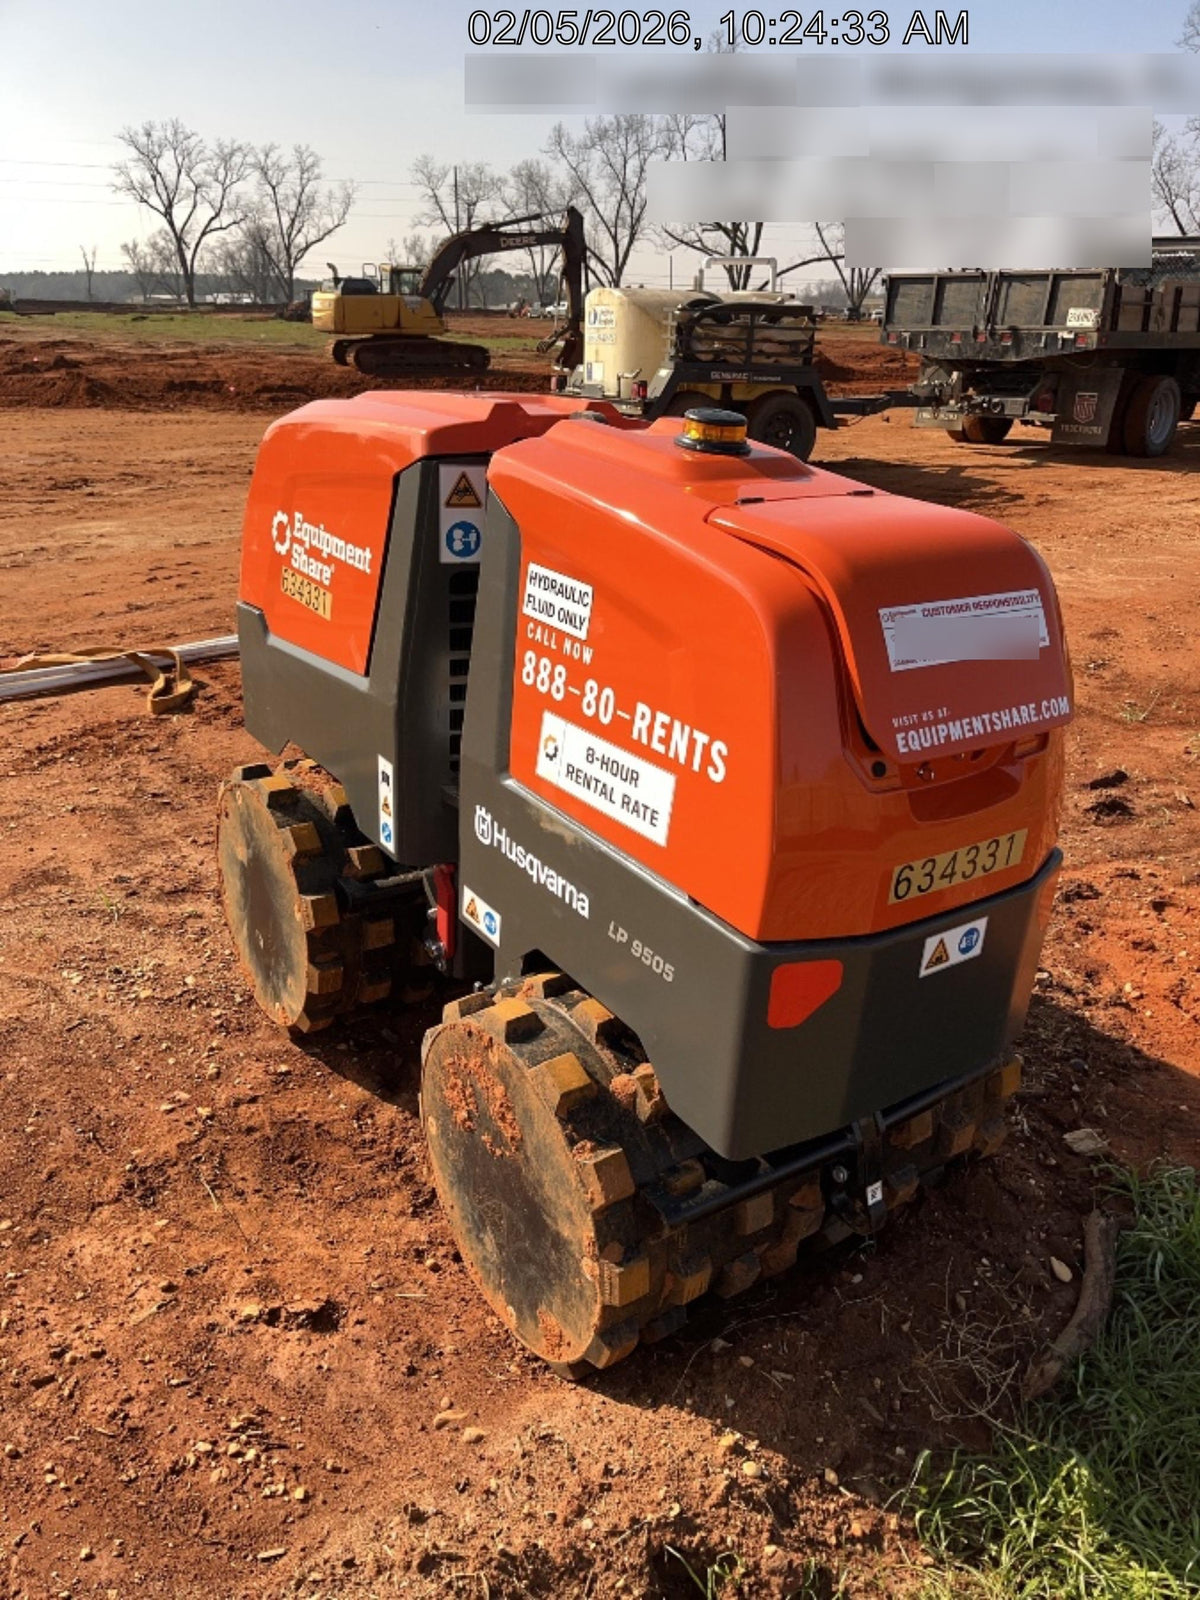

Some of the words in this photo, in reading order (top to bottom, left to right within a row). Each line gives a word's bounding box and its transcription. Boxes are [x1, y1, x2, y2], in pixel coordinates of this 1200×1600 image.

[291, 542, 331, 587] Share
[293, 512, 372, 574] Equipment
[282, 568, 327, 615] 634331
[529, 570, 590, 608] HYDRAULIC
[921, 603, 971, 617] CUSTOMER
[972, 594, 1041, 611] RESPONSIBILITY
[526, 594, 556, 618] FLUID
[557, 607, 586, 632] ONLY
[527, 622, 557, 650] CALL
[563, 638, 593, 665] NOW
[522, 650, 728, 783] 888-80-RENTS
[892, 715, 918, 728] VISIT
[923, 710, 934, 721] US
[896, 697, 1070, 753] EQUIPMENTSHARE.COM
[586, 746, 640, 788] 8-HOUR
[565, 763, 616, 804] RENTAL
[621, 794, 659, 828] RATE
[493, 821, 590, 920] Husqvarna
[894, 833, 1015, 900] 634331
[608, 920, 628, 944] LP
[630, 939, 675, 983] 9505
